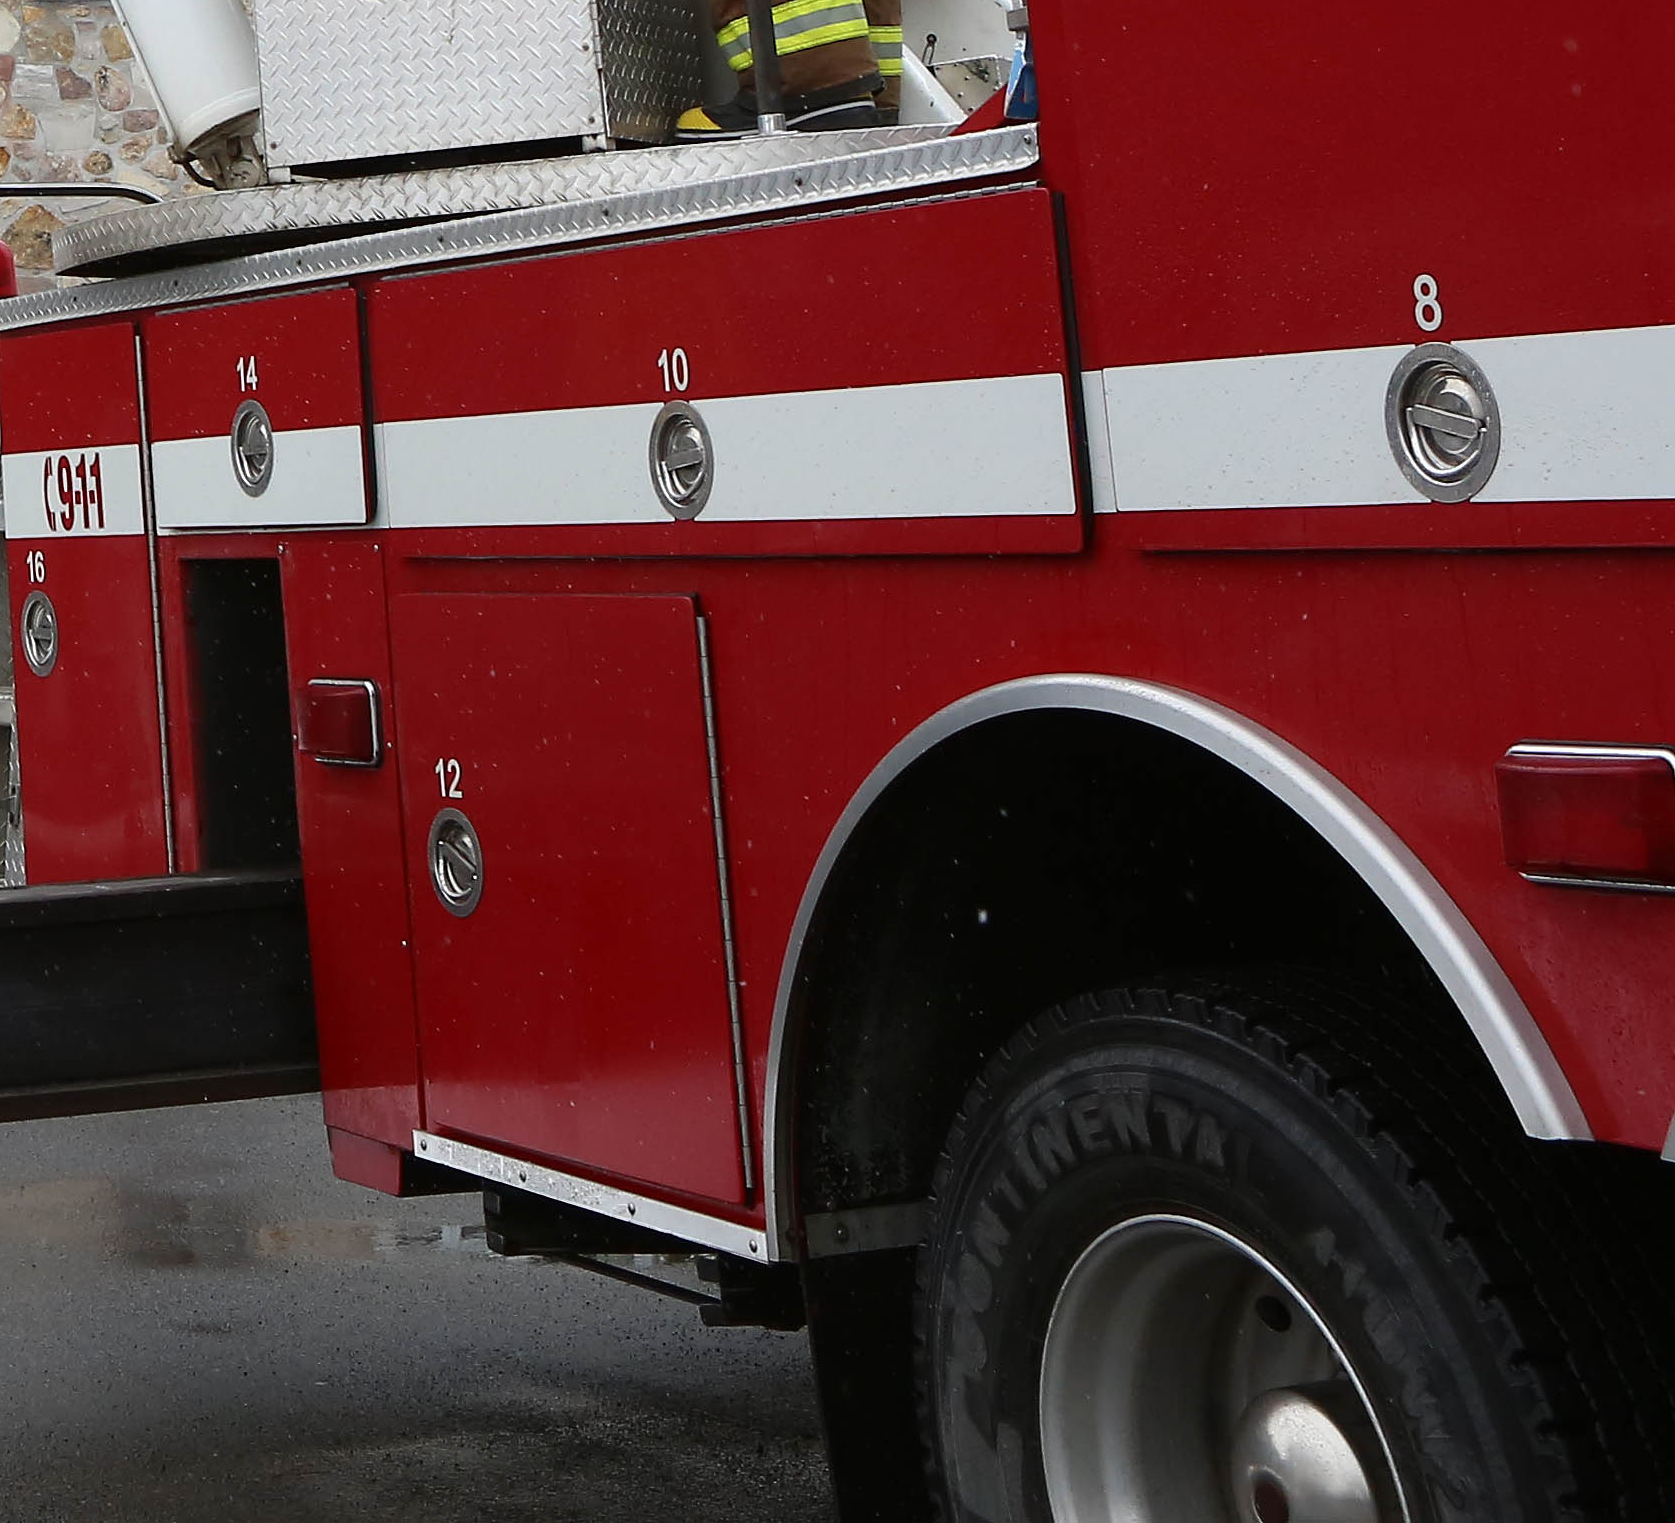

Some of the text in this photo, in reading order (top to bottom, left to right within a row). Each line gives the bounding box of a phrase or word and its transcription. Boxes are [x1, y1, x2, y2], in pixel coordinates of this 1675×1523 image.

[1412, 273, 1443, 333] 8
[235, 355, 259, 393] 14
[656, 346, 689, 393] 10
[26, 550, 45, 583] 16
[434, 757, 464, 800] 12
